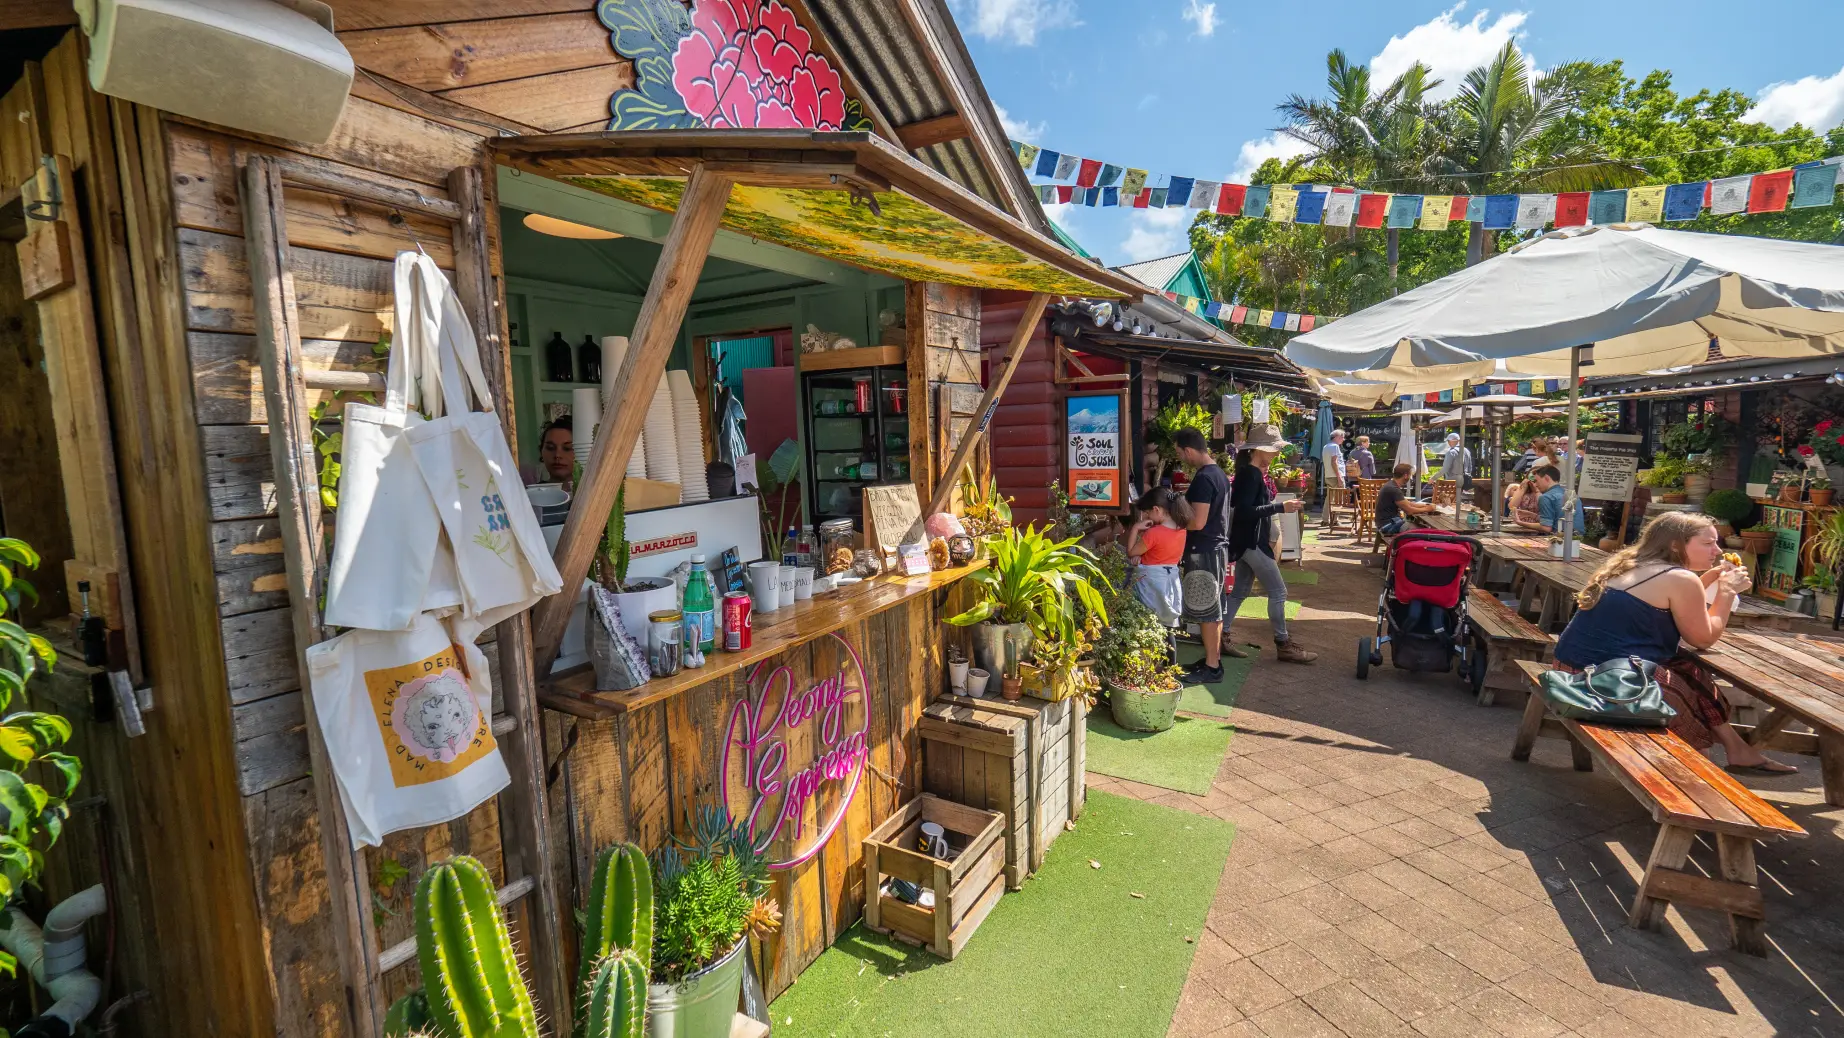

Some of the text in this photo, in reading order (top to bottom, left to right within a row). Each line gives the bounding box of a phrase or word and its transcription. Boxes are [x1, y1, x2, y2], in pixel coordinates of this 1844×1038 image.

[1086, 438, 1114, 449] SOUL
[1088, 456, 1117, 467] SUSHI
[382, 679, 405, 727] ELENA
[734, 666, 860, 787] Peony
[395, 744, 425, 771] MAD
[749, 731, 865, 854] Espresso
